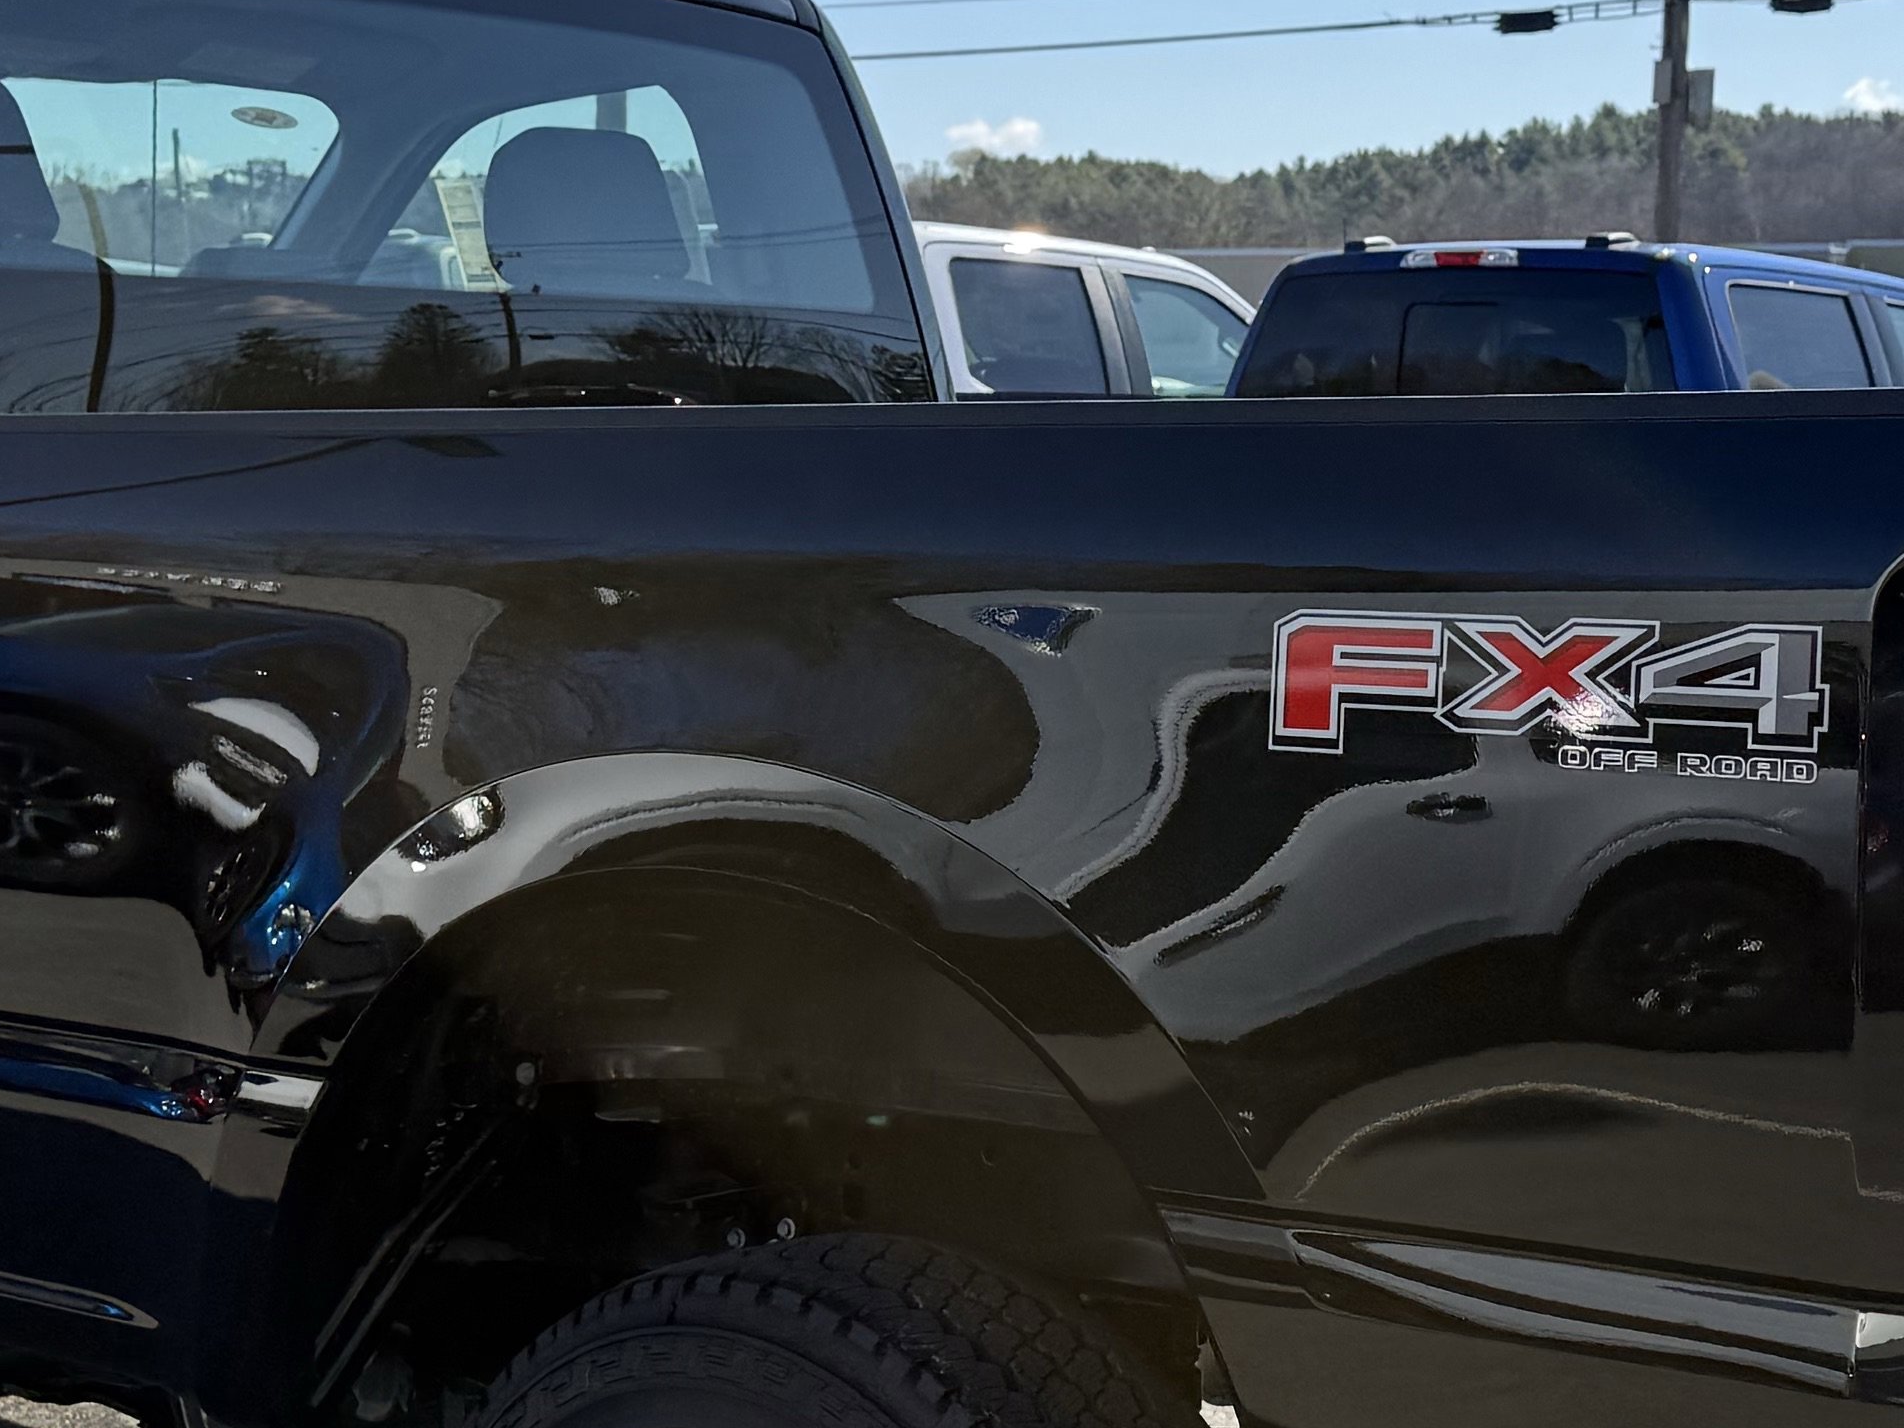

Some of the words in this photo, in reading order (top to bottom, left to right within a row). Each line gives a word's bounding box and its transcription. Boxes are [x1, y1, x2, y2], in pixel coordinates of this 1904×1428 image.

[1268, 608, 1830, 754] FX4
[1558, 745, 1658, 774] OFF
[1675, 752, 1819, 785] ROAD
